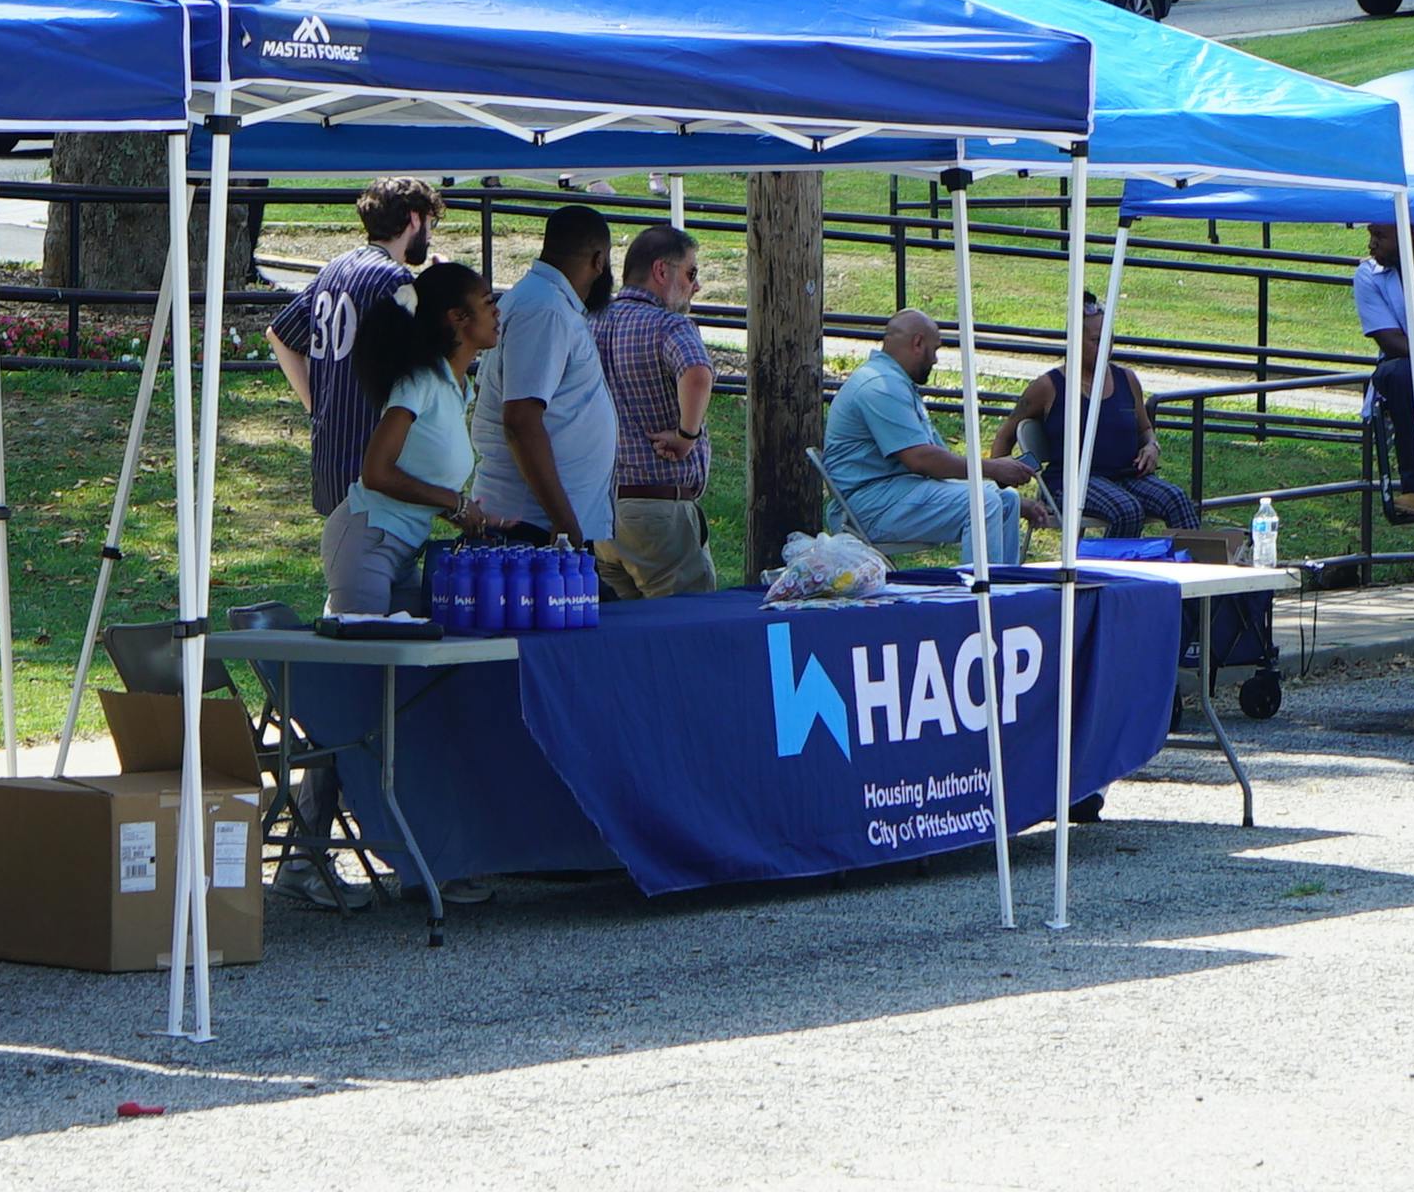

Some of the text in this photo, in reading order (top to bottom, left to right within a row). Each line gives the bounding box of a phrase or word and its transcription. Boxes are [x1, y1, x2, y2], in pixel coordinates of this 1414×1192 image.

[261, 40, 317, 60] MASTER
[310, 290, 358, 362] 30
[851, 625, 1044, 746] HACP
[863, 767, 992, 809] Housing Authority
[867, 804, 996, 849] City of Pittsburgh
